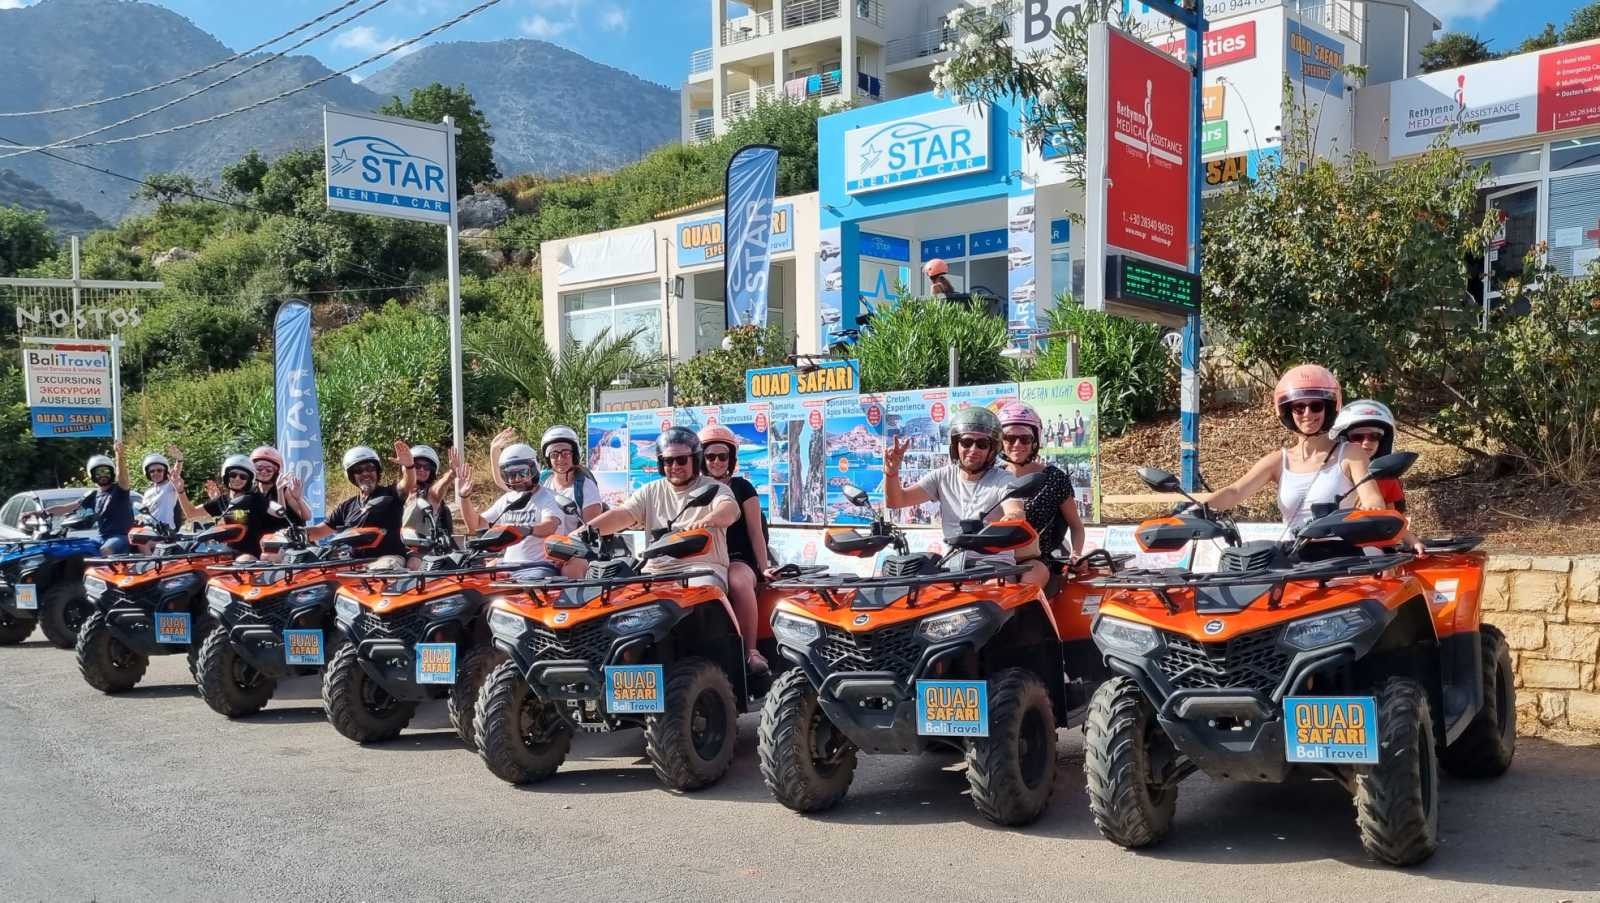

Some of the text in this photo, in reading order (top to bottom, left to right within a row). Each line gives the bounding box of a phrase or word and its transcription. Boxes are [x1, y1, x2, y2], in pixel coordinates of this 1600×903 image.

[1561, 88, 1583, 97] Doctors
[1117, 100, 1146, 125] Rethymno
[1408, 104, 1454, 119] Rethymno
[1408, 102, 1520, 129] MEDICAL ASSISTANCE
[1116, 115, 1146, 140] MEDICAL
[1151, 132, 1183, 154] ASSISTANCE
[888, 129, 971, 170] STAR
[362, 155, 444, 193] STAR
[858, 159, 973, 190] RENT A CAR
[336, 187, 442, 211] RENT A CAR
[681, 221, 723, 250] QUAD
[745, 198, 768, 293] STAR
[16, 305, 140, 329] NOSTOS
[30, 352, 107, 368] BaliTravel
[40, 386, 101, 395] ЭКСКУРСИИ
[751, 366, 853, 398] QUAD SAFARI
[40, 397, 101, 405] AUSFLUEGE
[887, 395, 910, 403] Cretan
[887, 403, 925, 413] Experience
[37, 414, 105, 423] QUAD SAFARI
[287, 368, 311, 486] STAR
[422, 648, 450, 664] QUAD
[422, 663, 450, 673] SAFARI
[613, 671, 656, 688] QUAD
[614, 688, 656, 700] SAFARI
[926, 687, 979, 708] QUAD
[927, 707, 979, 721] SAFARI
[1295, 703, 1365, 729] QUAD
[926, 722, 980, 733] BaliTravel
[1297, 728, 1366, 745] SAFARI
[1296, 745, 1368, 759] BaliTravel
